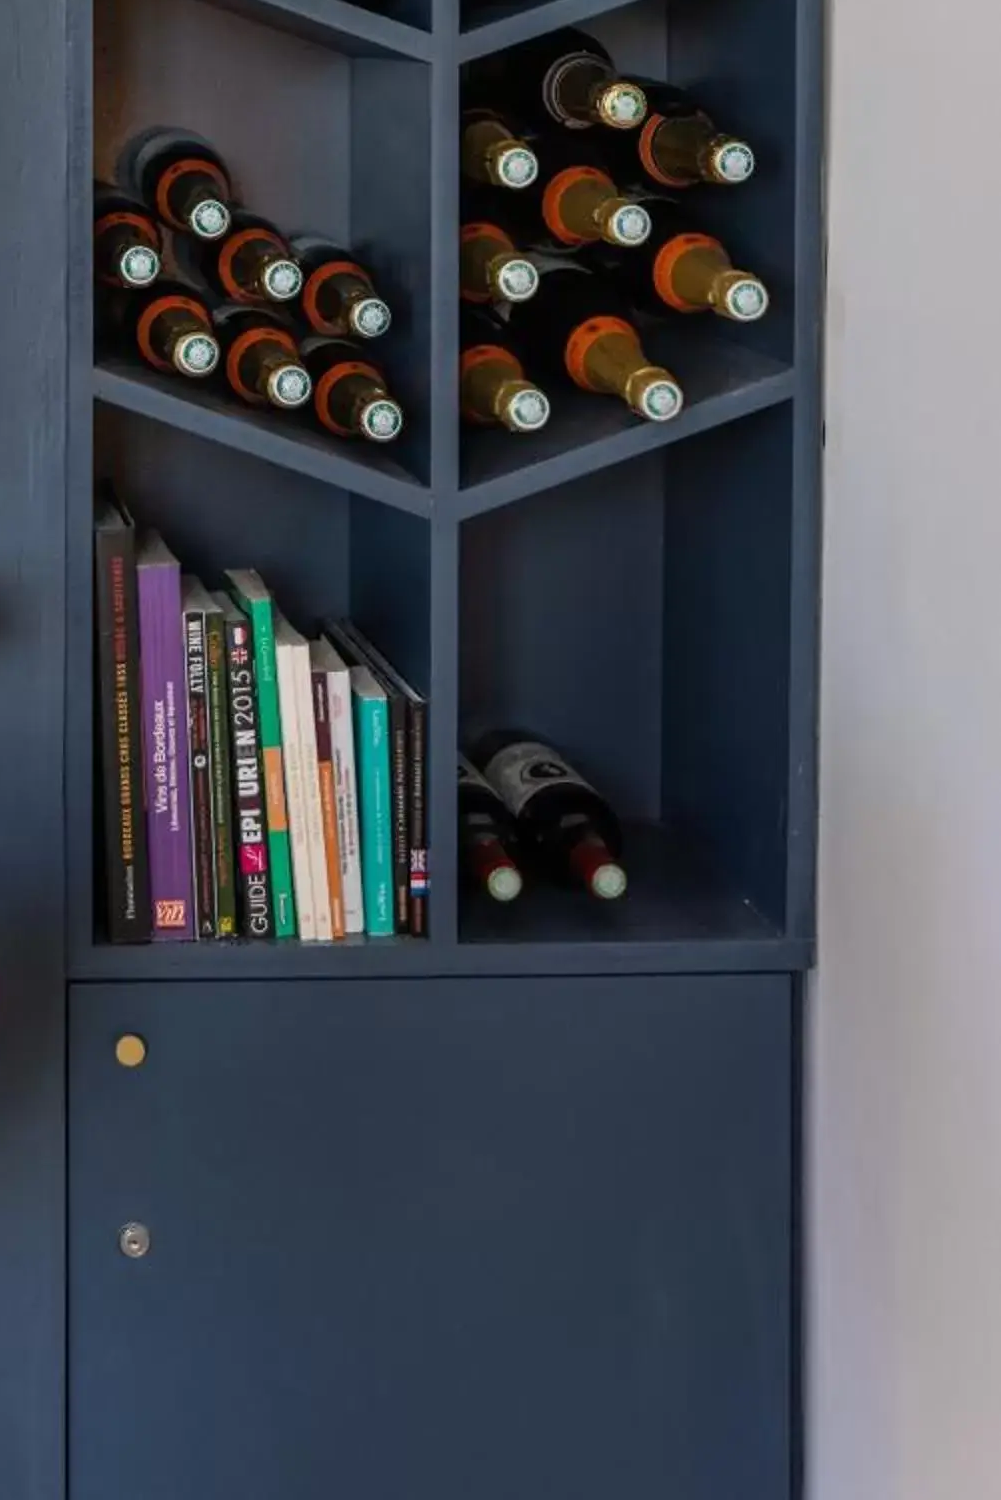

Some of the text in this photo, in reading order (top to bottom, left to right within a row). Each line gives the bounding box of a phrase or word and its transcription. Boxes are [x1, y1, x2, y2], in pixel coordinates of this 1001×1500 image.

[188, 621, 203, 653] WINE
[189, 658, 204, 693] FOLLY
[230, 669, 254, 726] 2015
[152, 700, 168, 814] Vins de Bordeaux
[250, 874, 269, 933] GUIDE
